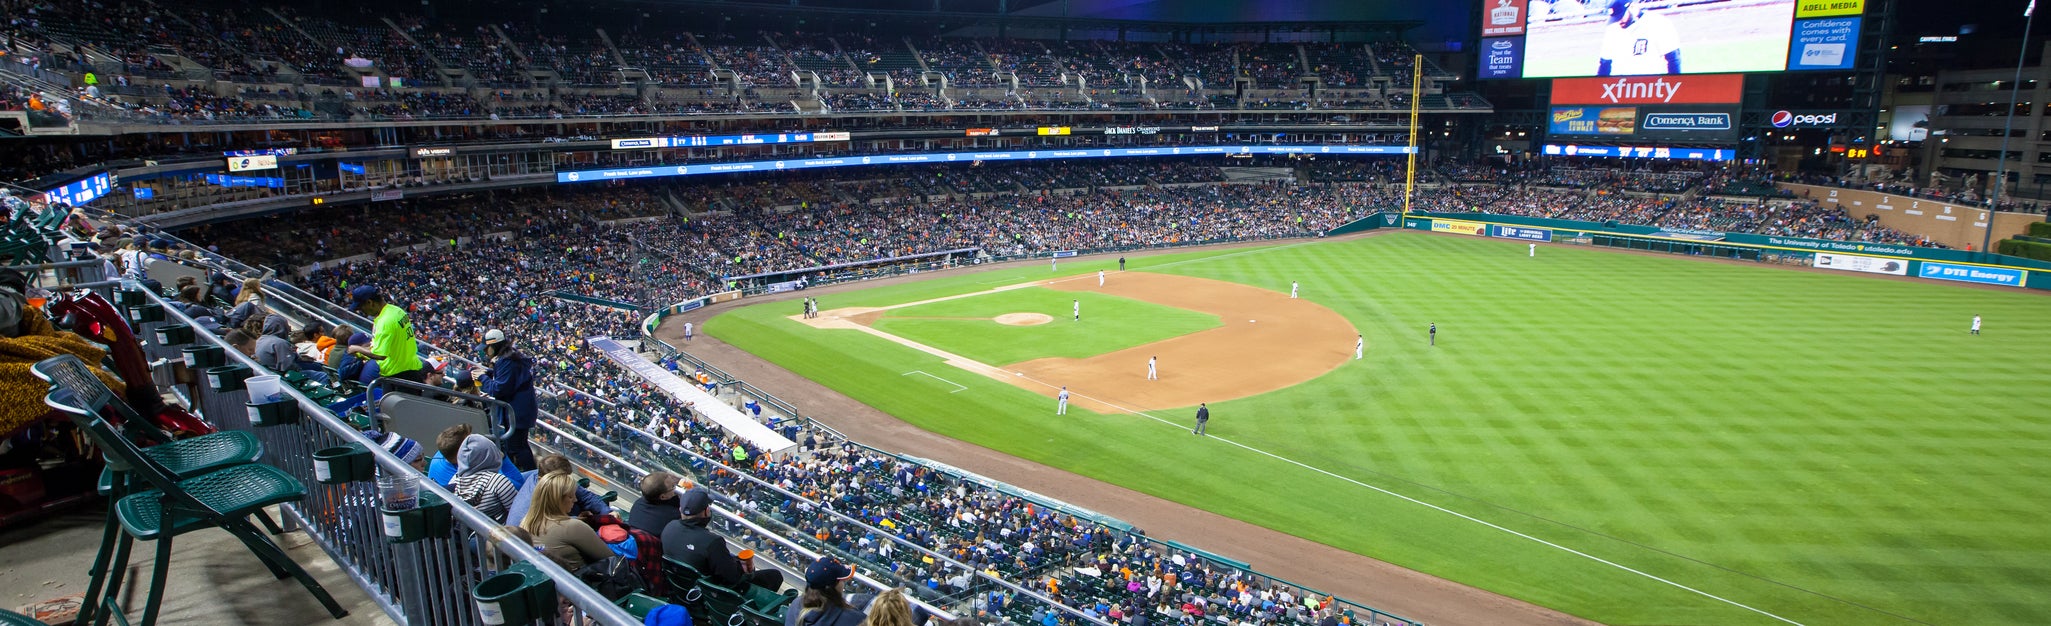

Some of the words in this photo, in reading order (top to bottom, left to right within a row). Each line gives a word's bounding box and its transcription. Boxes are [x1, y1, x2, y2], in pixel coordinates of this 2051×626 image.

[1802, 20, 1852, 28] Confidence
[1831, 26, 1851, 34] with
[1800, 35, 1824, 43] every
[1489, 55, 1512, 64] Team
[1601, 78, 1682, 103] xfinity
[1697, 116, 1724, 125] Bank
[1793, 112, 1837, 125] pepsi
[1104, 126, 1116, 134] JACK
[1501, 226, 1517, 236] Lite
[1783, 239, 1820, 248] University
[1821, 240, 1829, 248] of
[1831, 242, 1857, 250] Toledo
[1864, 246, 1913, 255] utoledo.edu
[1943, 267, 1968, 276] DTE
[1970, 270, 2016, 283] Energy
